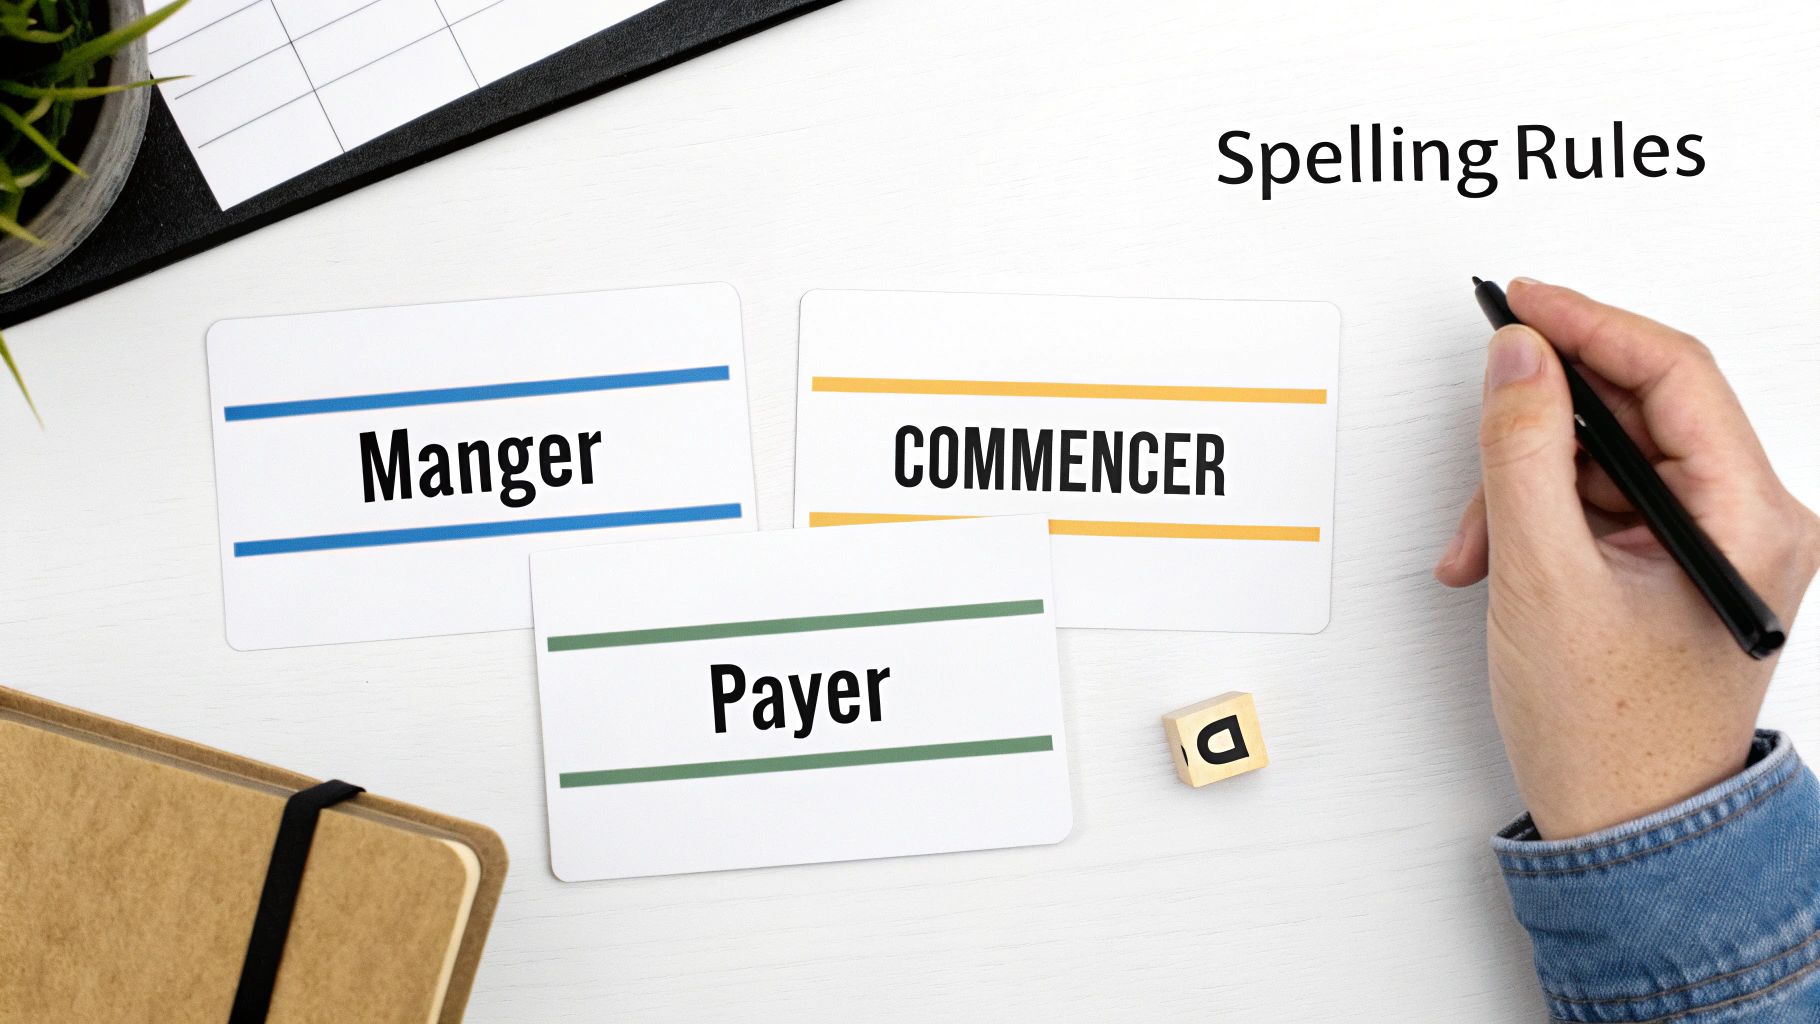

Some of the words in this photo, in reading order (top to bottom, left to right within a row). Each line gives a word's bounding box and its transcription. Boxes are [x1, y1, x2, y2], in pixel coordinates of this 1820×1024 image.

[359, 428, 602, 508] Manger
[894, 424, 1226, 497] COMMENCER
[710, 663, 891, 739] Payer
[1196, 714, 1250, 765] D
